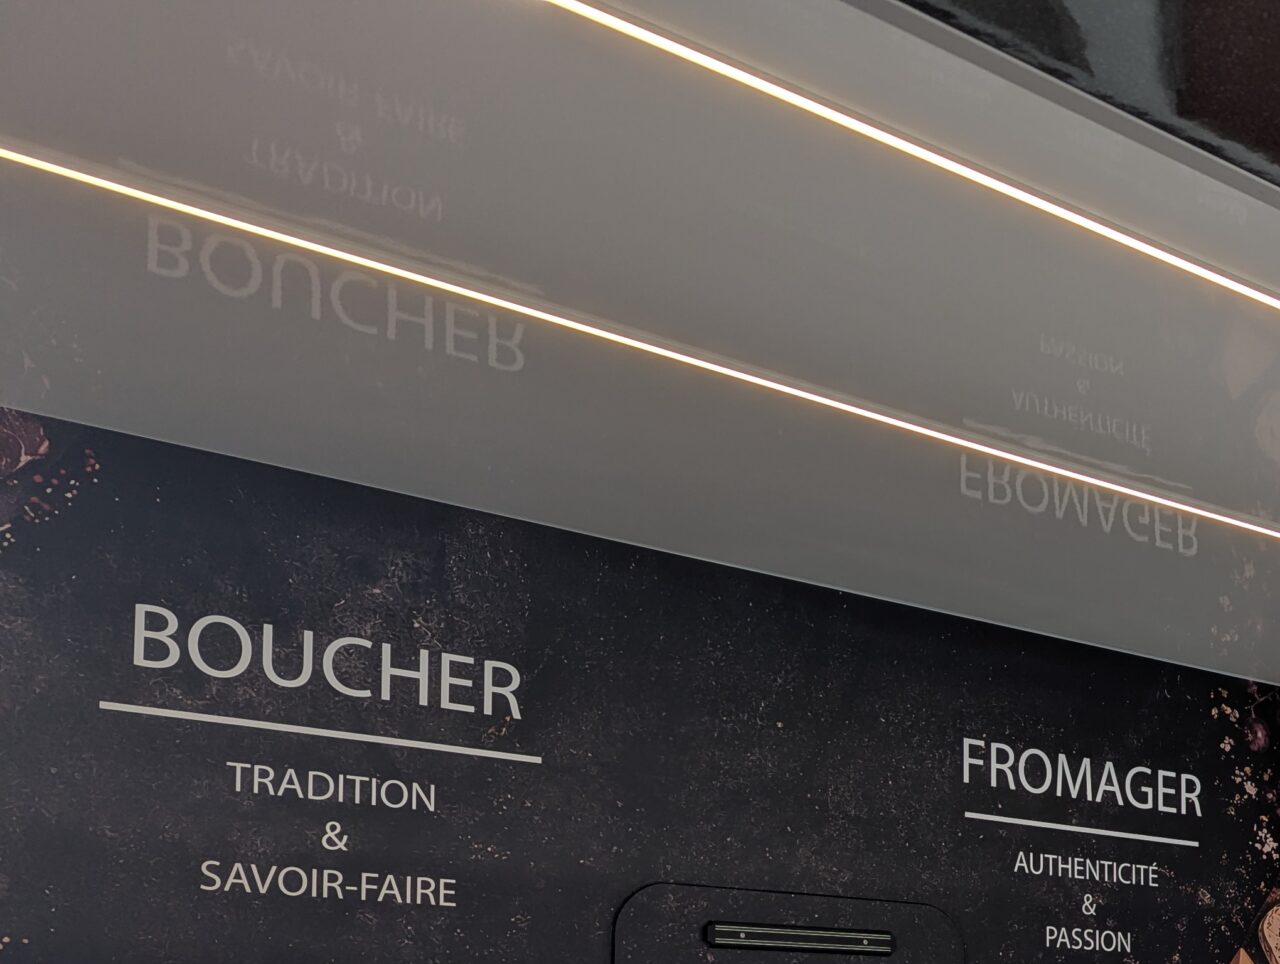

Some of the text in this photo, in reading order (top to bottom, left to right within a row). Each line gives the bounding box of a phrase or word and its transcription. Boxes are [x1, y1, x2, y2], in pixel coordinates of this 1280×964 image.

[133, 603, 522, 720] BOUCHER
[226, 761, 437, 812] TRADITION
[963, 737, 1203, 818] FROMAGER
[321, 820, 349, 852] &
[200, 860, 457, 907] SAVOIR-FAIRE
[1014, 851, 1159, 887] AUTHENTICITÉ
[1081, 893, 1097, 916] &
[1046, 925, 1131, 953] PASSION
